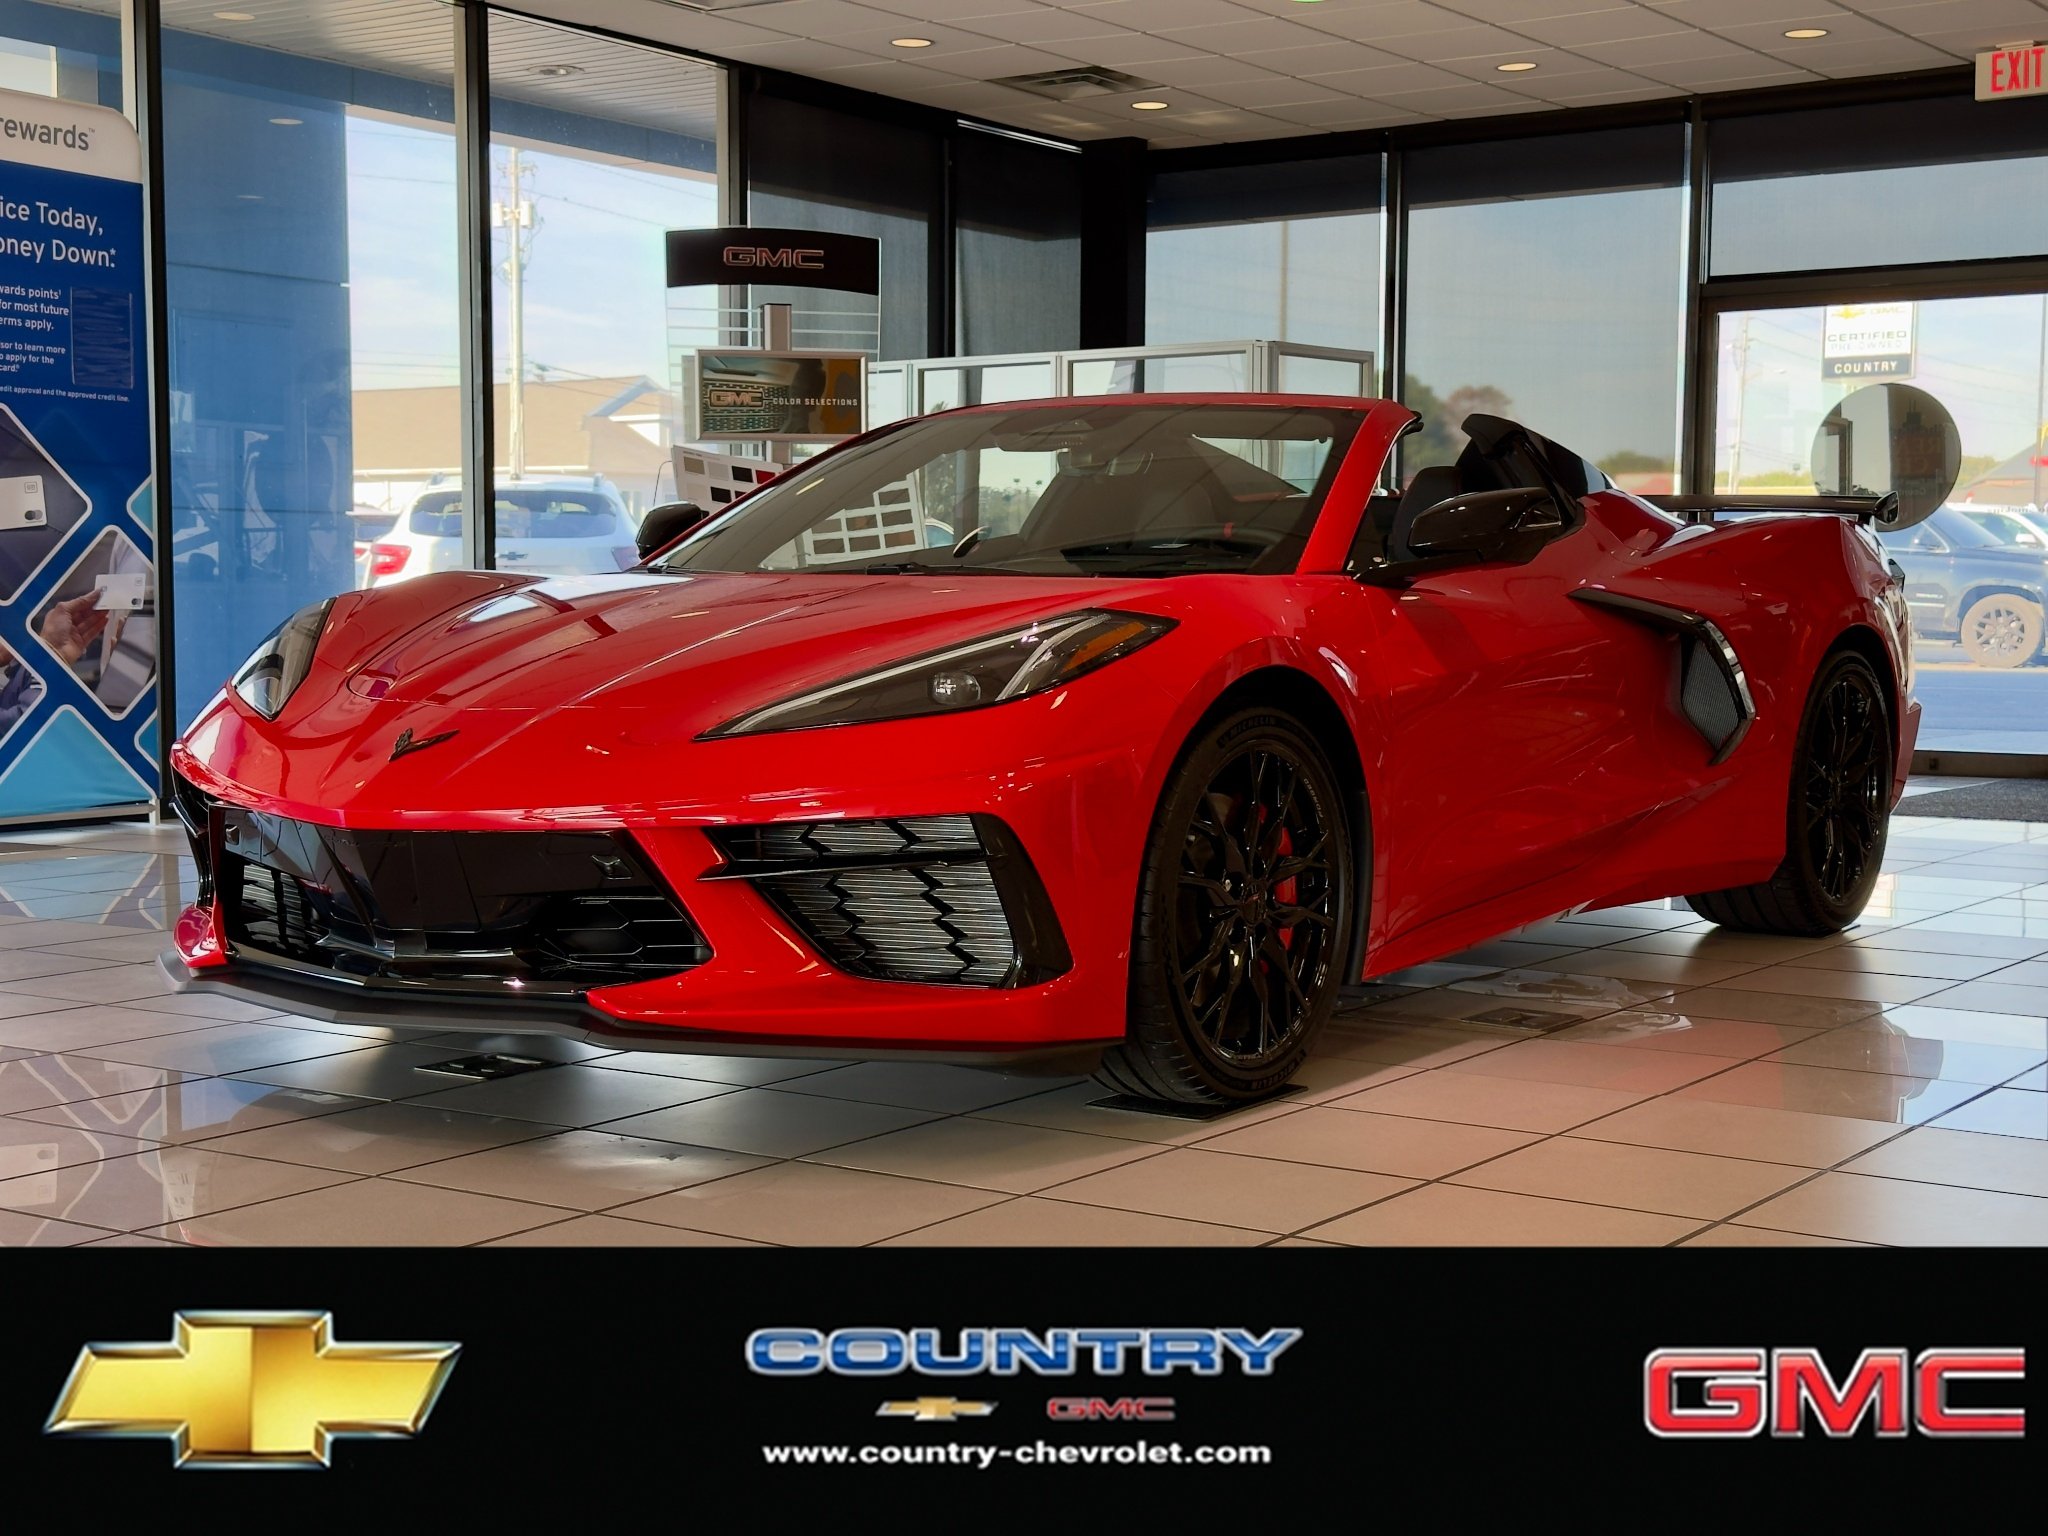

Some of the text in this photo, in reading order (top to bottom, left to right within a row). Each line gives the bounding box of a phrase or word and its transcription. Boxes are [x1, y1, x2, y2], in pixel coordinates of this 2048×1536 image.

[1991, 48, 2045, 92] EXIT
[35, 201, 104, 236] Today,
[723, 246, 824, 269] GMC
[14, 302, 38, 313] most
[40, 303, 70, 316] future
[25, 318, 54, 332] apply.
[1827, 331, 1907, 342] CERTIFIED
[15, 341, 23, 351] to
[24, 342, 45, 353] learn
[46, 345, 66, 355] more
[5, 353, 27, 364] apply
[28, 353, 40, 363] for
[41, 355, 55, 365] the
[1834, 360, 1898, 375] COUNTRY
[13, 386, 42, 395] approval
[43, 387, 55, 396] and
[55, 388, 67, 397] the
[67, 390, 97, 400] approved
[97, 393, 116, 402] credit
[711, 391, 763, 406] GMC
[772, 397, 858, 406] COLOR SELECTIONS
